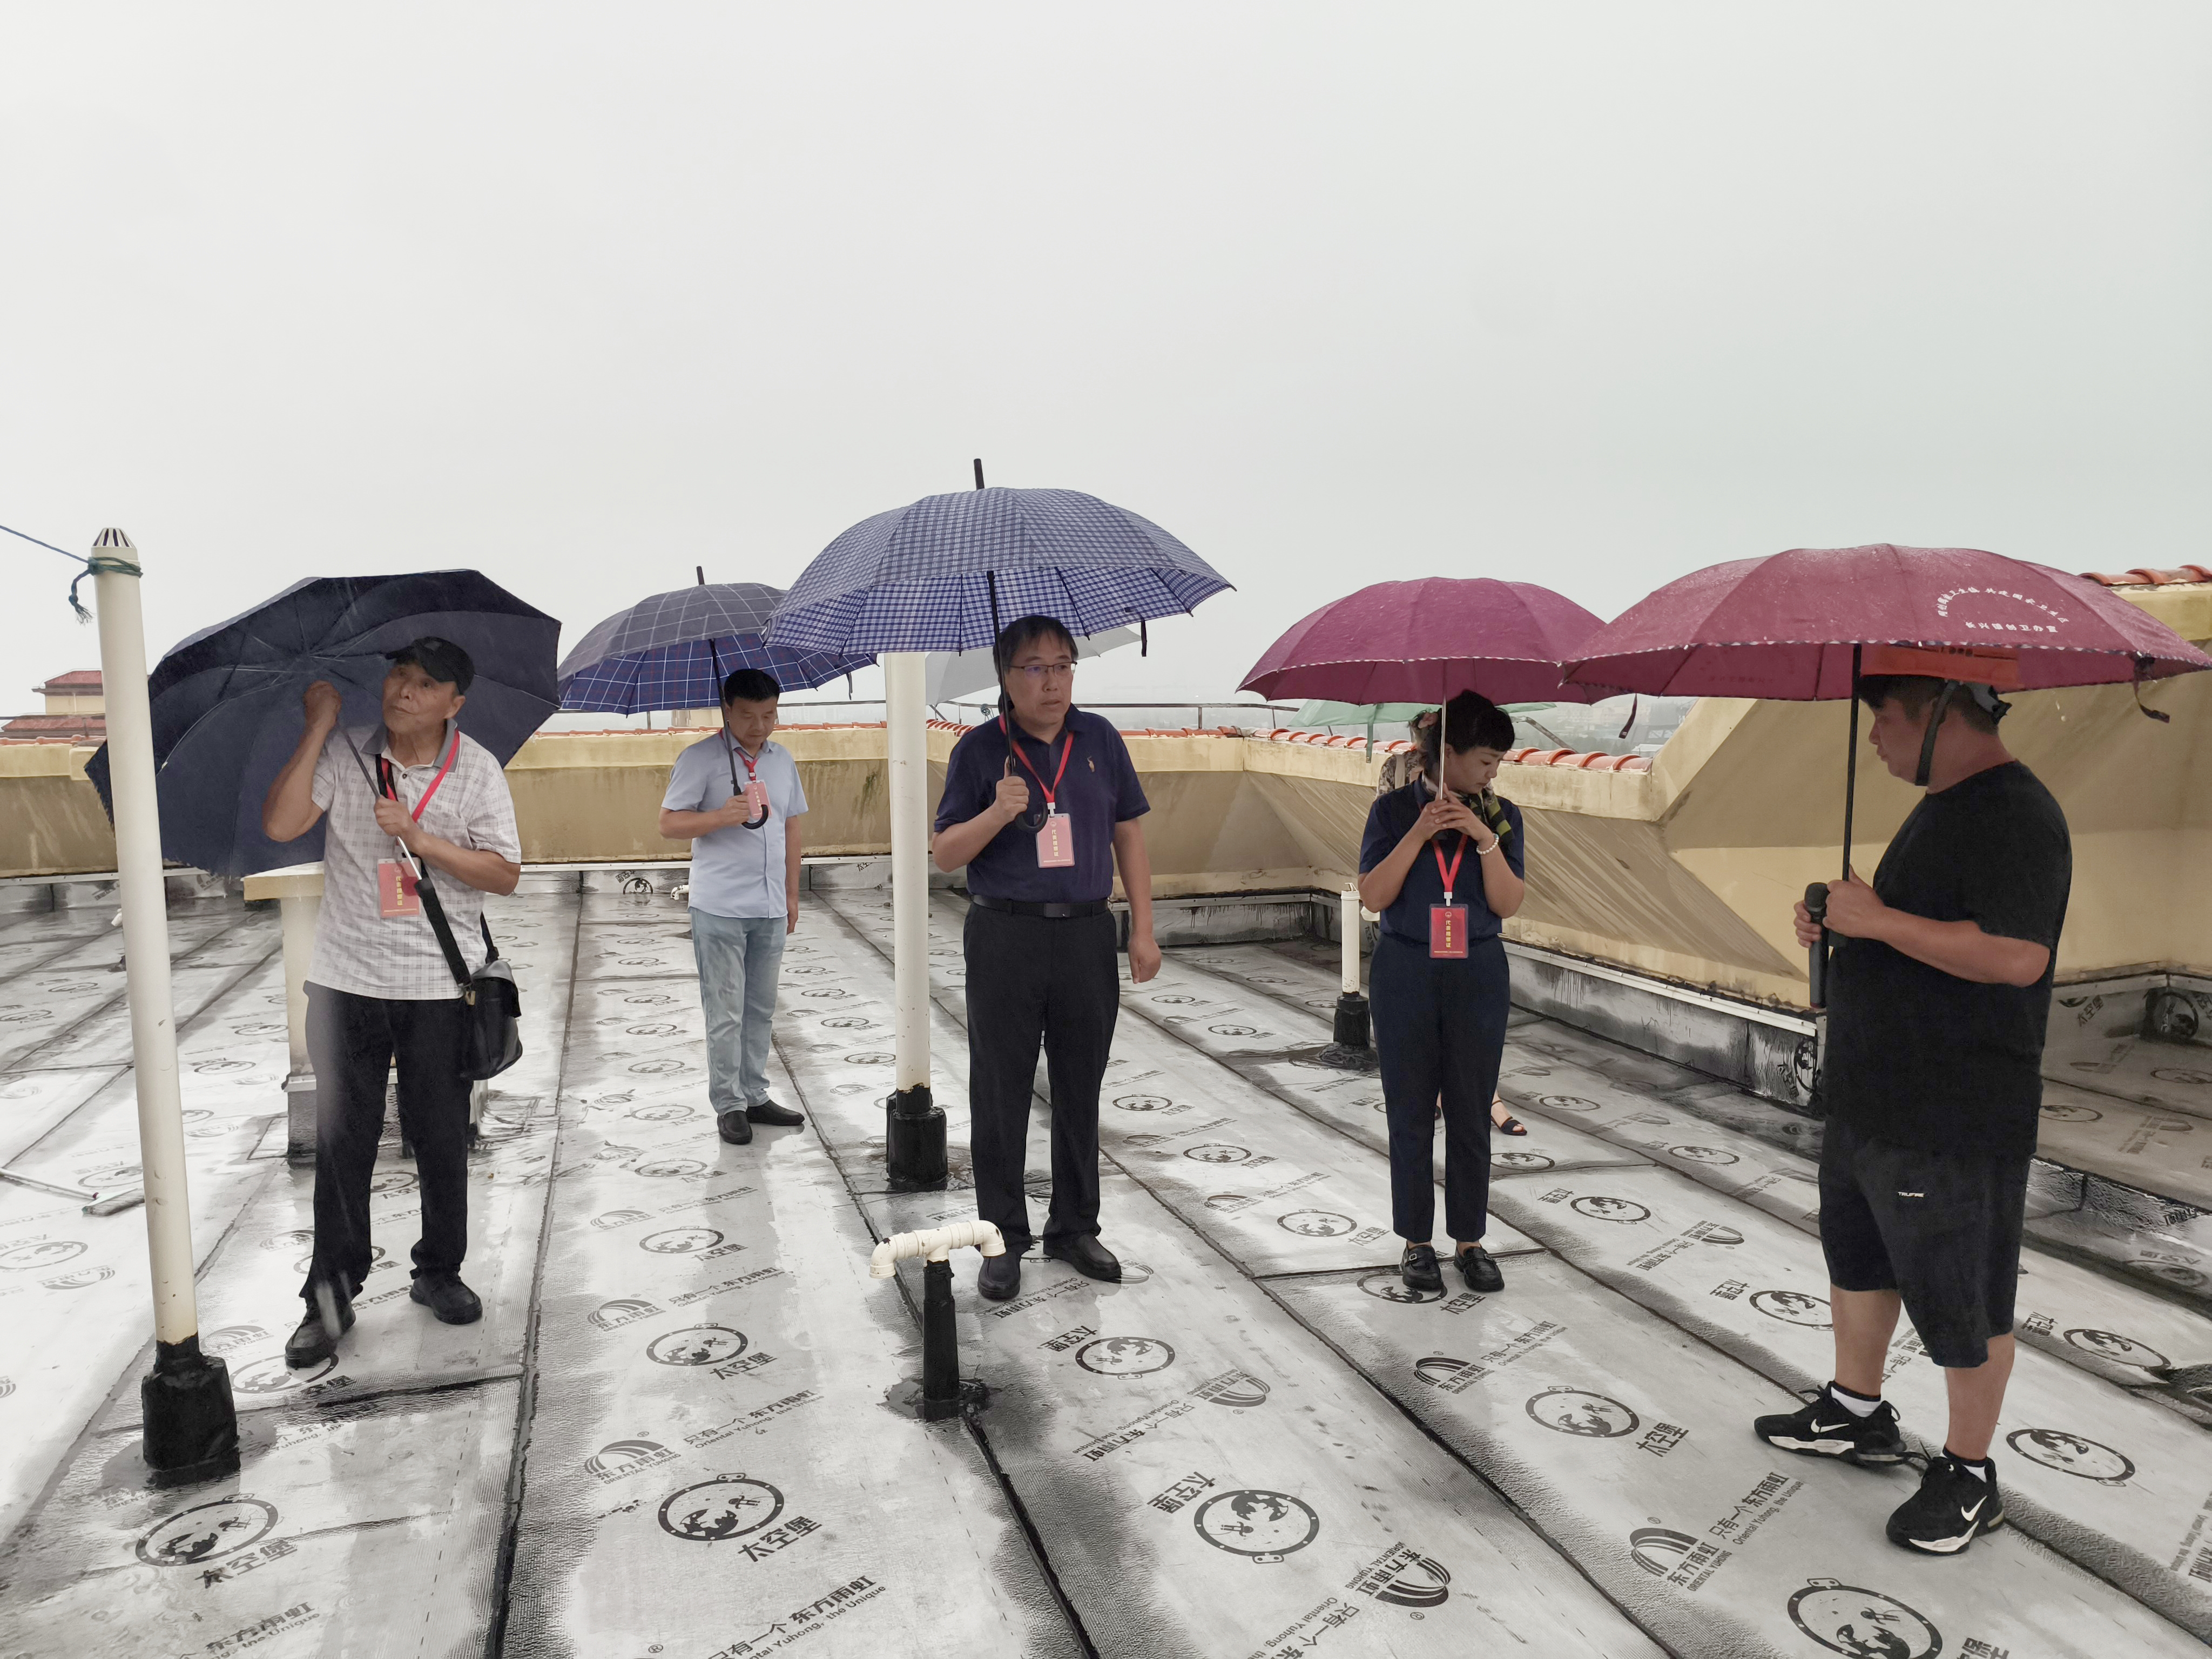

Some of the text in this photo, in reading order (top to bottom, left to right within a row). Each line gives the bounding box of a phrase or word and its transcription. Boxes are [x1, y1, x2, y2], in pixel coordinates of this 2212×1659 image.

[1347, 1226, 1391, 1246] 太空堡
[692, 1243, 748, 1261] 太空堡
[1439, 1293, 1486, 1314] 太空堡
[1710, 1279, 1750, 1300] 太空堡
[2021, 1311, 2059, 1336] 太空堡
[1040, 1325, 1098, 1352] 太空堡
[710, 1352, 778, 1380] 太空堡
[1438, 1364, 1487, 1391] 东方雨虹
[1194, 1371, 1251, 1400] 东方雨虹
[1116, 1412, 1152, 1431] Yuhong,
[1147, 1399, 1179, 1416] Oriental
[695, 1431, 734, 1449] Oriental
[733, 1415, 775, 1432] Yuhong,
[775, 1406, 793, 1415] the
[1636, 1422, 1689, 1457] 太空堡
[594, 1448, 676, 1481] 东方雨虹
[604, 1466, 647, 1485] ORIENTAL
[1147, 1471, 1216, 1514] 太空堡
[1732, 1480, 1804, 1545] Oriental Yuhong, the Unique
[738, 1516, 822, 1562] 太空堡
[195, 1539, 298, 1588] 太空堡
[1344, 1566, 1374, 1589] YUHONG
[1355, 1549, 1421, 1596] 东方雨虹
[1667, 1541, 1720, 1587] 东方雨虹
[1687, 1549, 1732, 1591] ORIENTAL YUHONG
[773, 1622, 825, 1648] Yuhong,
[825, 1607, 847, 1620] the
[846, 1585, 886, 1609] Unique
[1301, 1597, 1338, 1623] Oriental
[1263, 1620, 1306, 1648] Yuhong,
